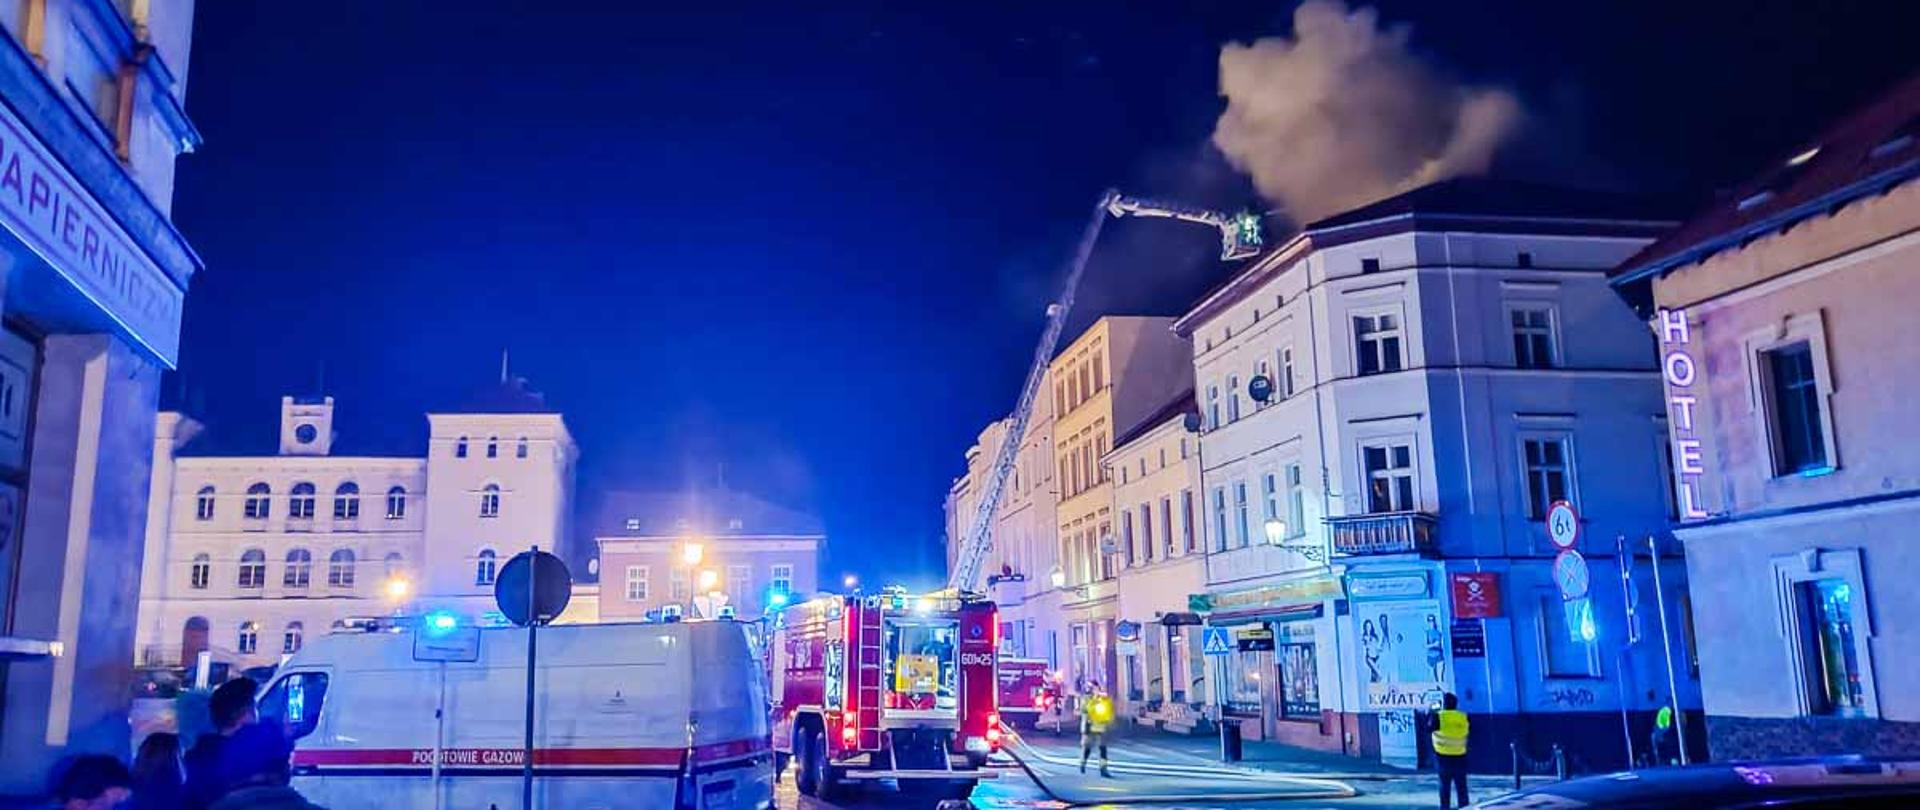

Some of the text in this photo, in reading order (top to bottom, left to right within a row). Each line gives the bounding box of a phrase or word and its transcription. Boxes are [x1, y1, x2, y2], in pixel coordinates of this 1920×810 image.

[1662, 309, 1707, 518] HOTEL
[412, 751, 525, 763] POTOWIE GAZOW
